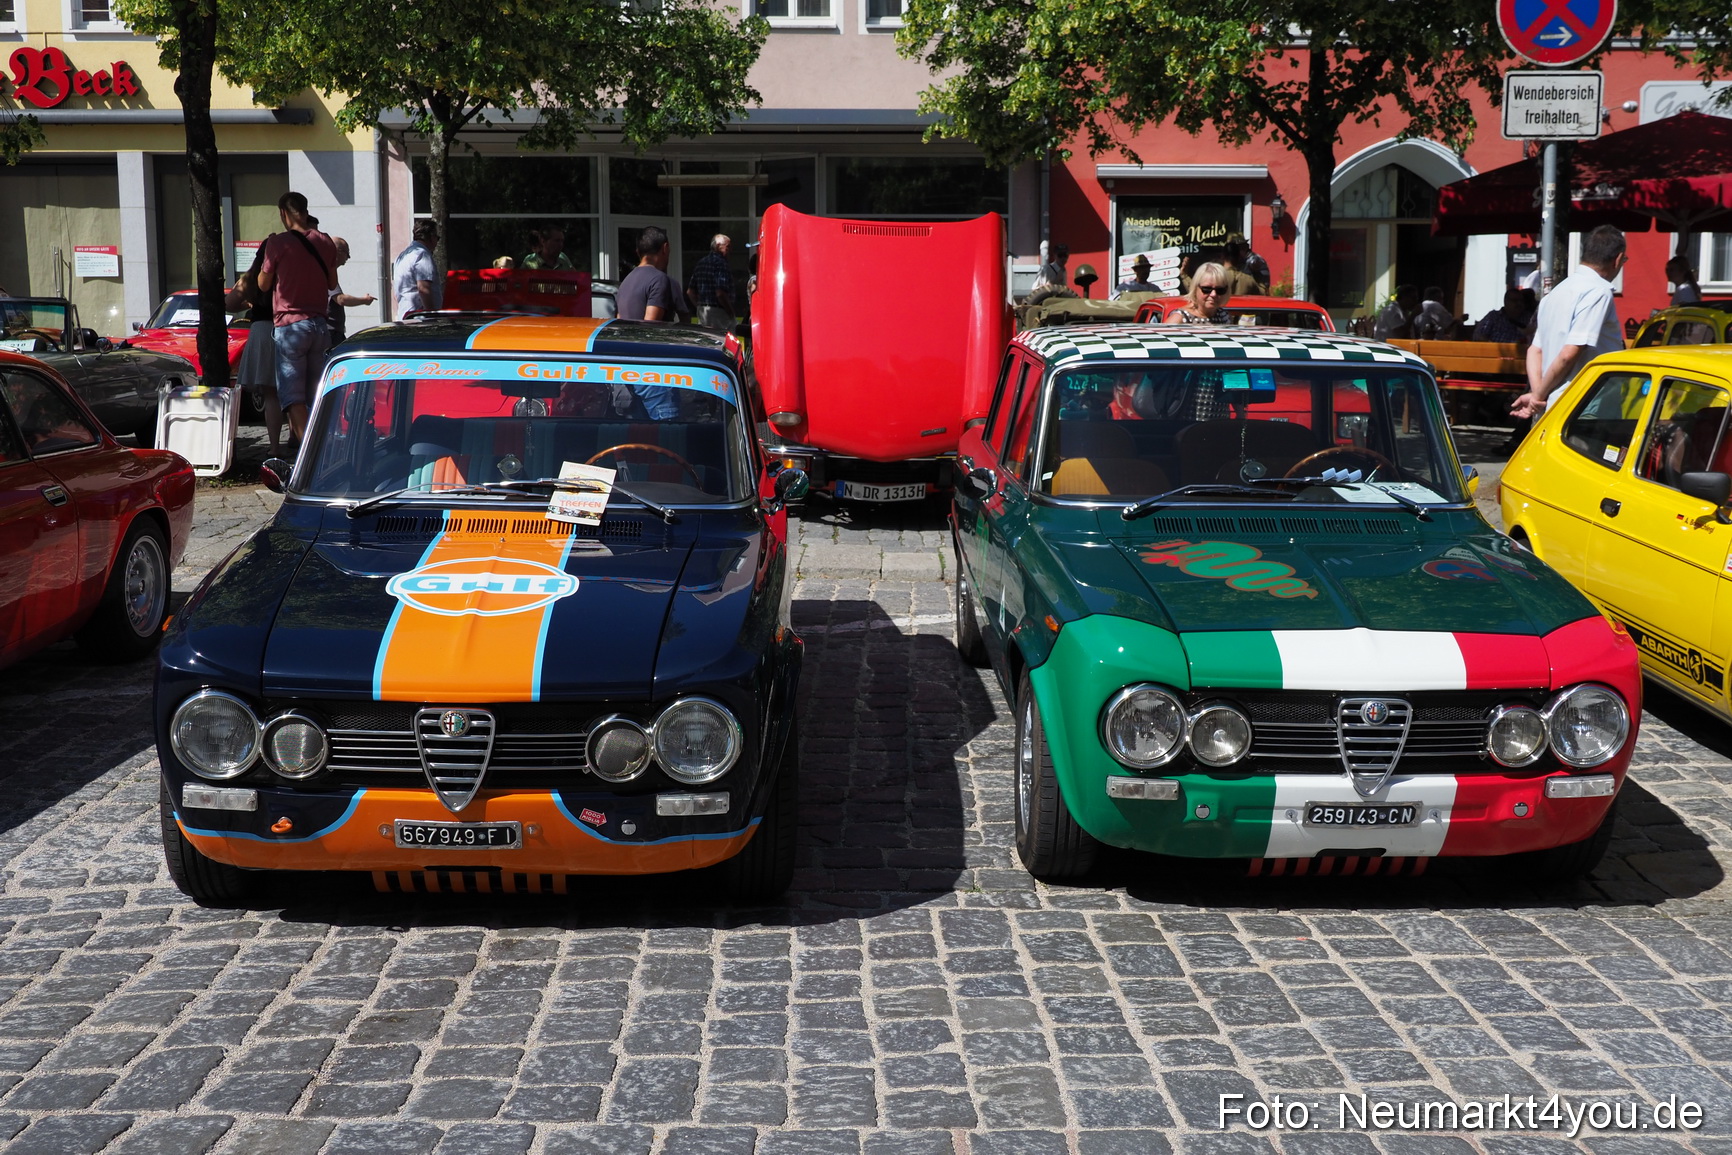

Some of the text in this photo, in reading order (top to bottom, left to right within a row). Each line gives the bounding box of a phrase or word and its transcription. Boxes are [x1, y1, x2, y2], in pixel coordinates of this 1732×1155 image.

[9, 47, 138, 108] Beck
[1513, 85, 1594, 101] Wendebereich
[1525, 109, 1580, 124] freihalten
[1126, 217, 1180, 227] Nagelstudio
[1155, 232, 1183, 249] Pro
[1186, 221, 1226, 242] Nails
[363, 362, 488, 380] Alfa Romeo
[517, 363, 693, 386] Gulf Team
[844, 483, 925, 500] N DR 1313H
[560, 500, 602, 508] TREFFEN
[400, 575, 568, 593] Gulf
[1641, 634, 1688, 669] ABARTH
[1312, 807, 1412, 824] 259143 CN
[403, 826, 475, 845] 567949
